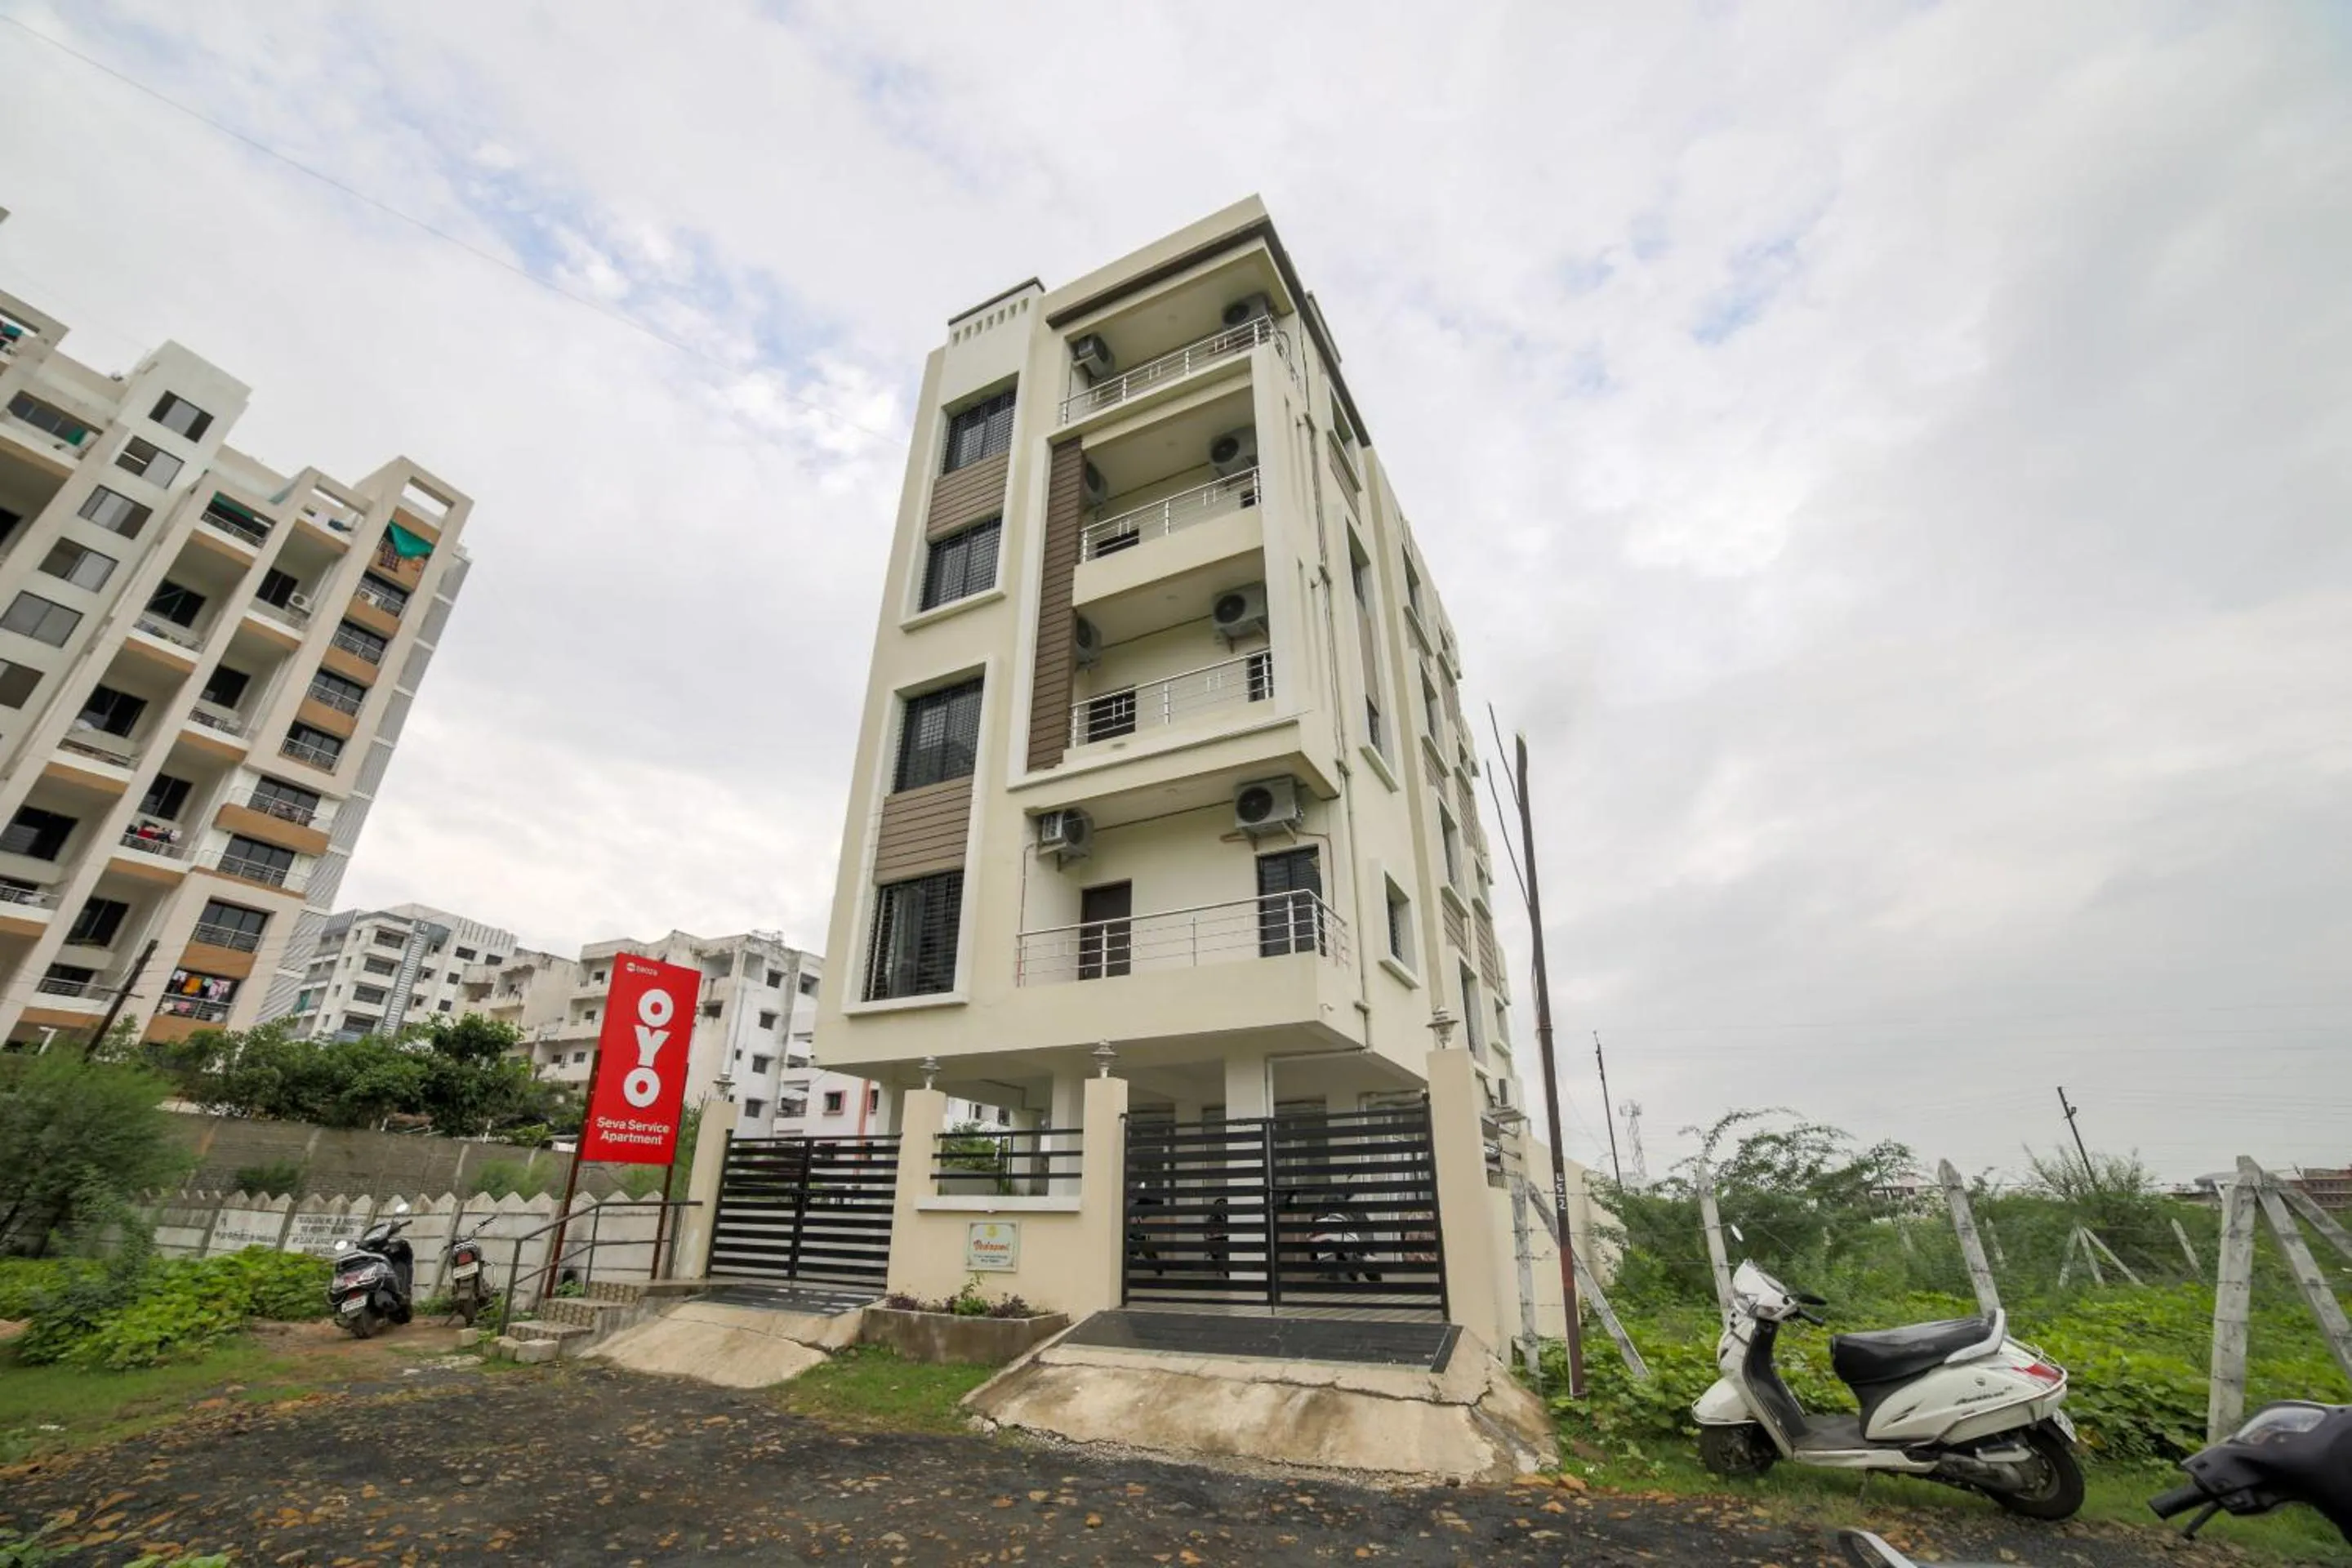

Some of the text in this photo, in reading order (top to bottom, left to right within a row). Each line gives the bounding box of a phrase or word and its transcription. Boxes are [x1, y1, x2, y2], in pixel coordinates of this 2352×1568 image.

[624, 989, 674, 1107] OYO
[597, 1116, 670, 1134] Seva Service
[600, 1129, 663, 1145] Apartment
